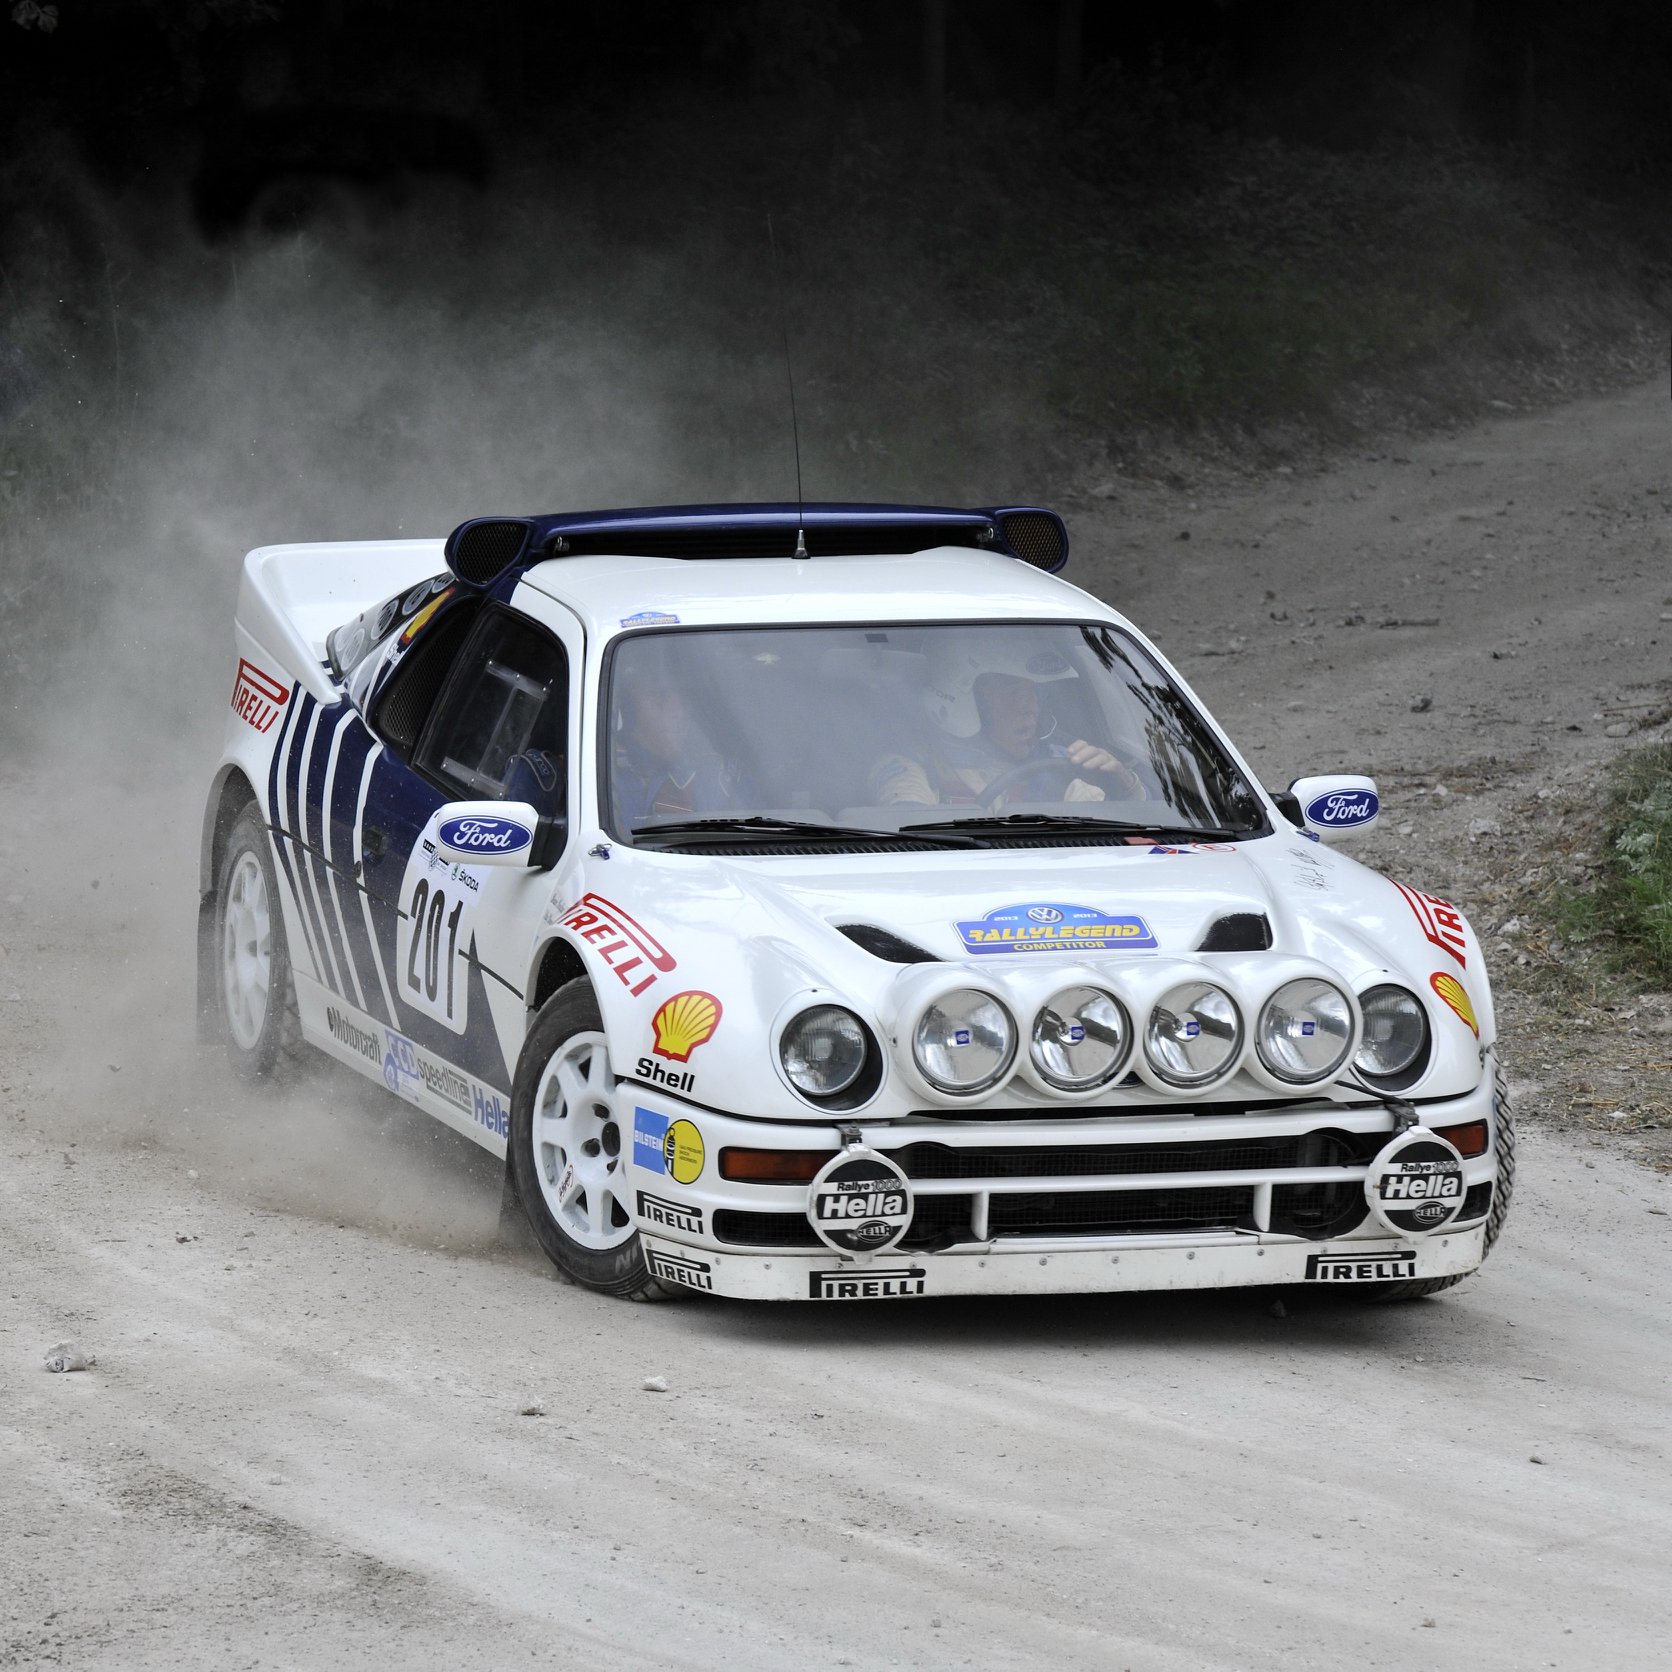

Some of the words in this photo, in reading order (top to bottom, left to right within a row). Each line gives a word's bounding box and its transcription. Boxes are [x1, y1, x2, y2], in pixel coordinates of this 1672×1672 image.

[231, 657, 290, 734] PIRELLI
[1323, 794, 1370, 821] Ford
[453, 820, 513, 848] Ford
[458, 869, 480, 893] ŠKODA
[969, 924, 1141, 942] RALLYLEGEND
[1386, 873, 1466, 970] PIRE
[408, 878, 463, 1020] 201
[557, 892, 677, 998] PIRELLI
[1013, 941, 1107, 951] COMPETITOR
[331, 1007, 382, 1066] Motorcraft
[417, 1057, 470, 1109] speedline
[635, 1057, 695, 1092] Shell
[472, 1084, 510, 1139] Hella
[634, 1129, 664, 1152] BILSTEIN
[1400, 1162, 1431, 1173] Rallye
[1433, 1160, 1459, 1173] 1000
[837, 1181, 870, 1192] Rallye
[871, 1178, 902, 1192] 1000
[1384, 1174, 1459, 1198] Hella
[636, 1190, 704, 1235] PIRELLI
[822, 1193, 903, 1218] Hella
[645, 1249, 712, 1290] PIRELLI
[1304, 1250, 1417, 1280] PIRELLI
[809, 1268, 926, 1299] PIRELLI
